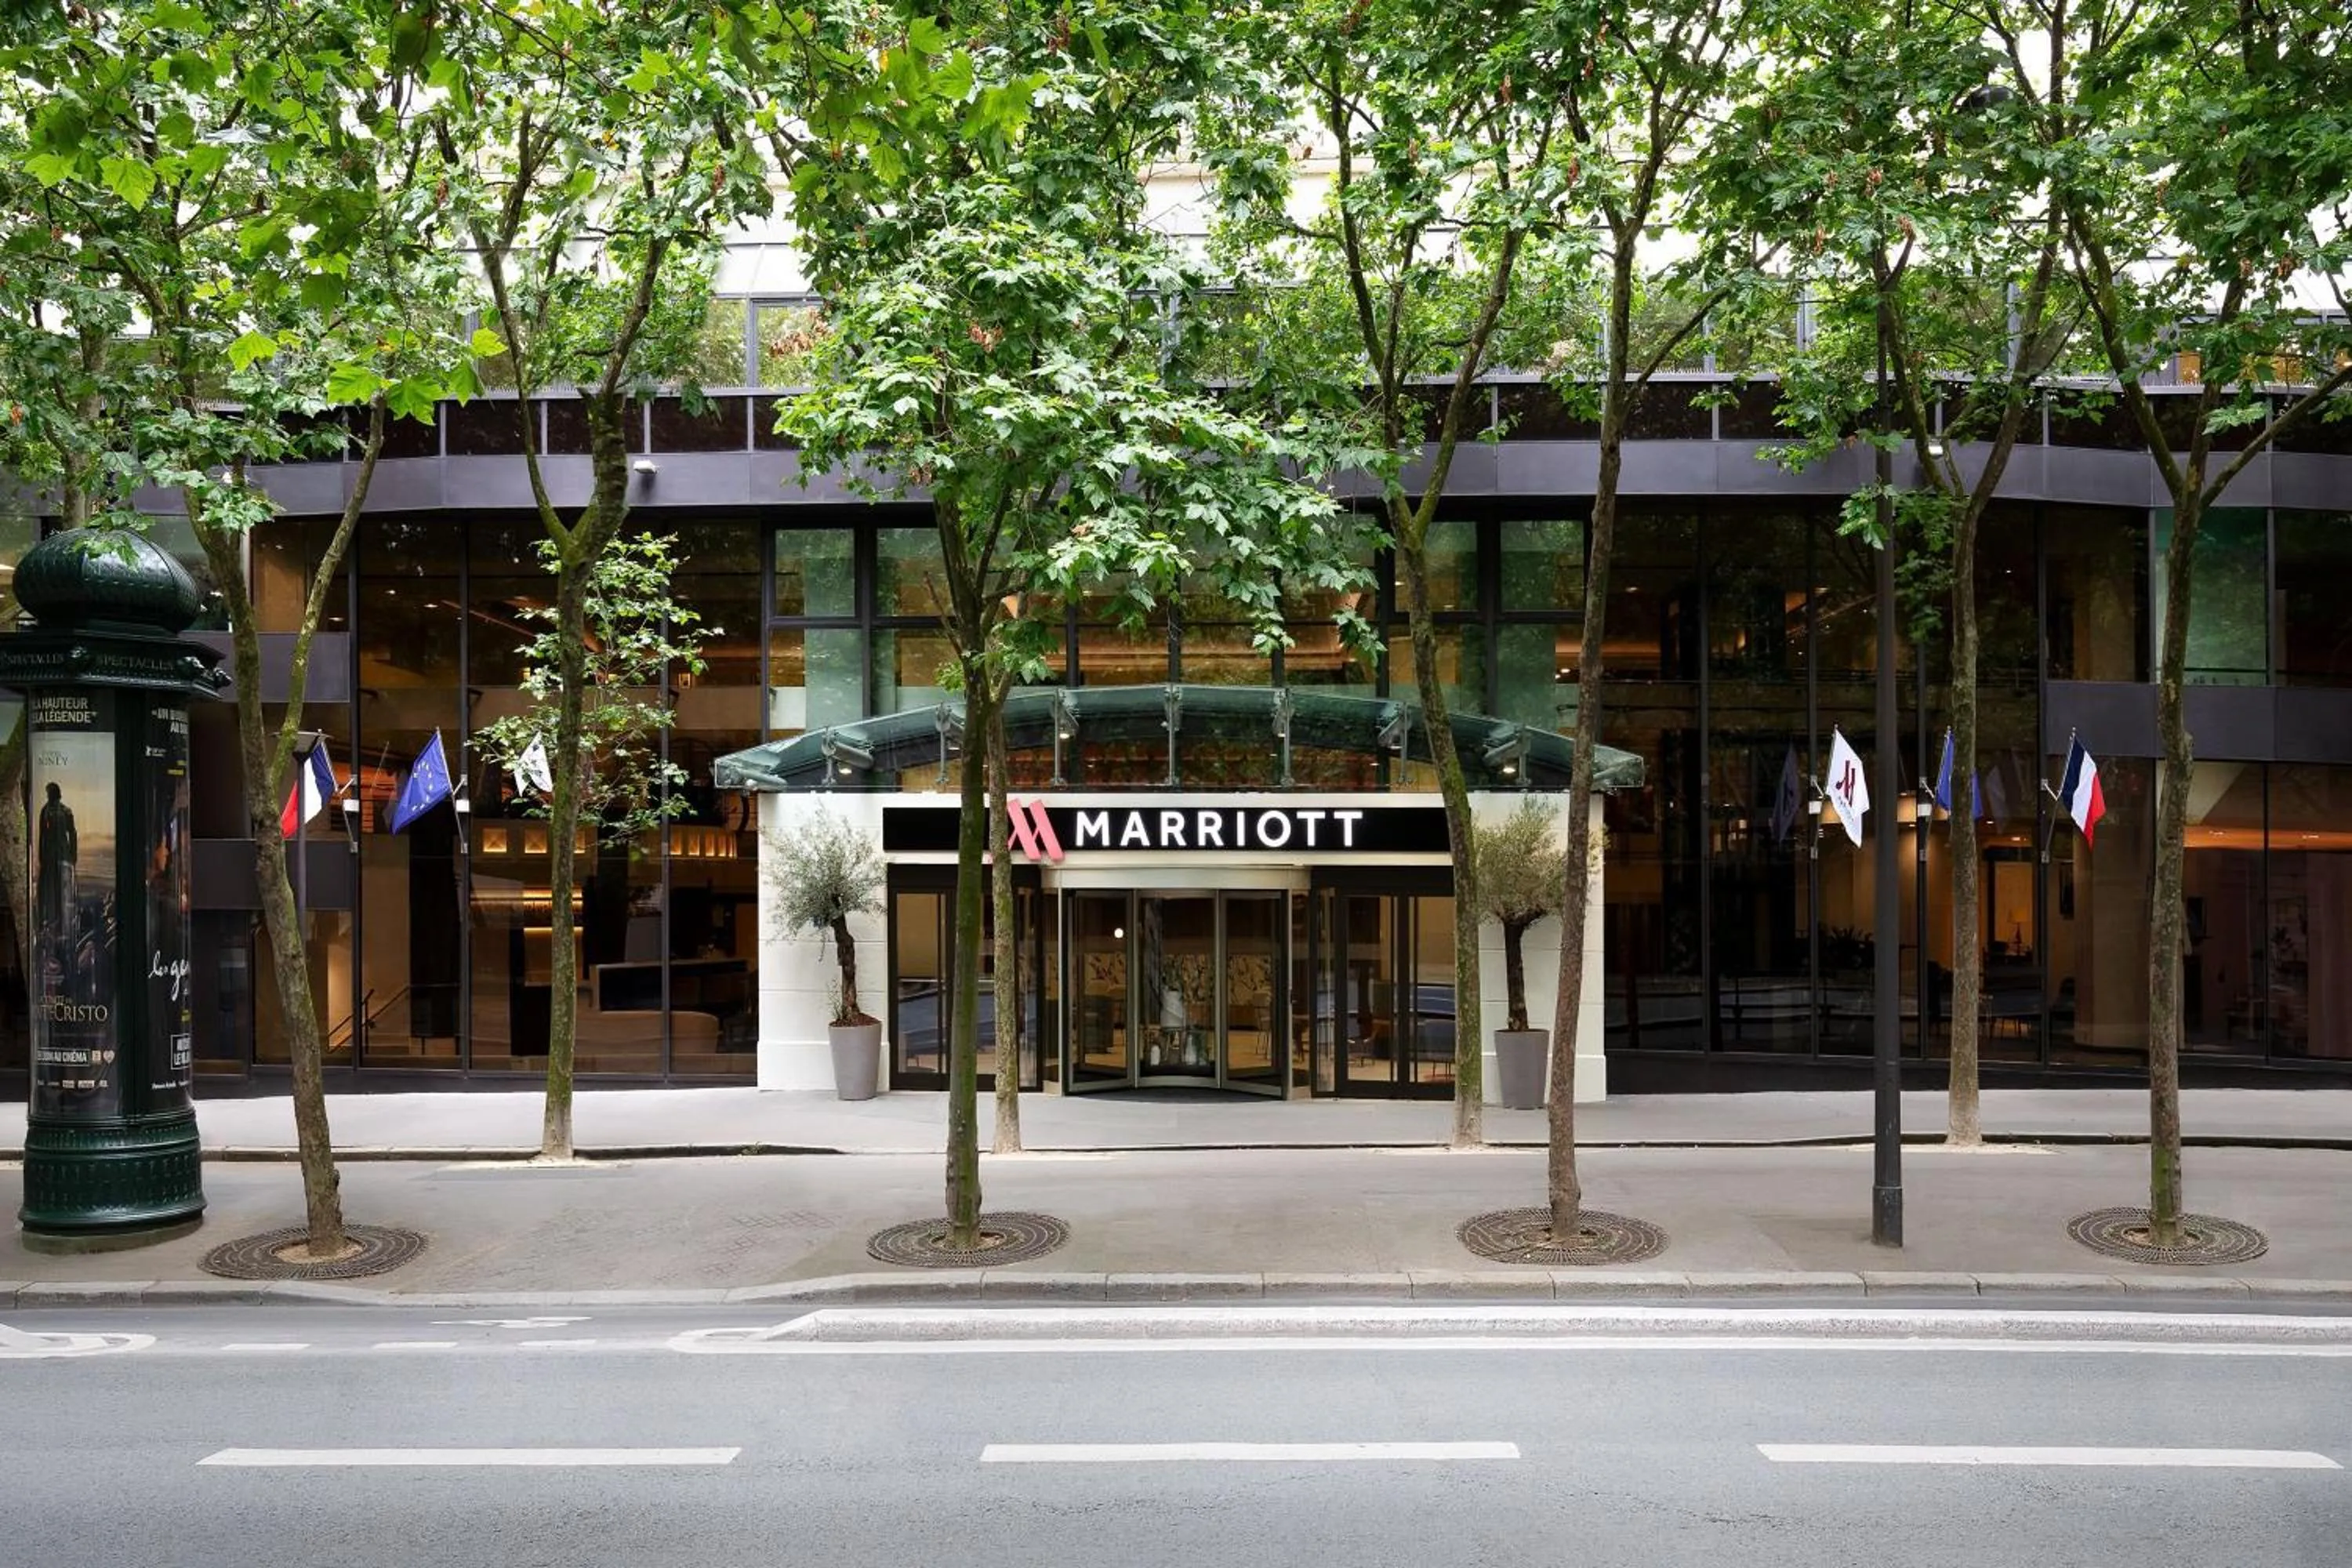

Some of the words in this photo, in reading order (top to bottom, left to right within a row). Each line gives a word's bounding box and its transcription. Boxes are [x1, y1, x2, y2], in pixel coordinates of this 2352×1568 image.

[96, 654, 176, 671] SPECTACLES
[42, 697, 89, 710] HAUTEUR
[1075, 810, 1363, 848] MARRIOTT
